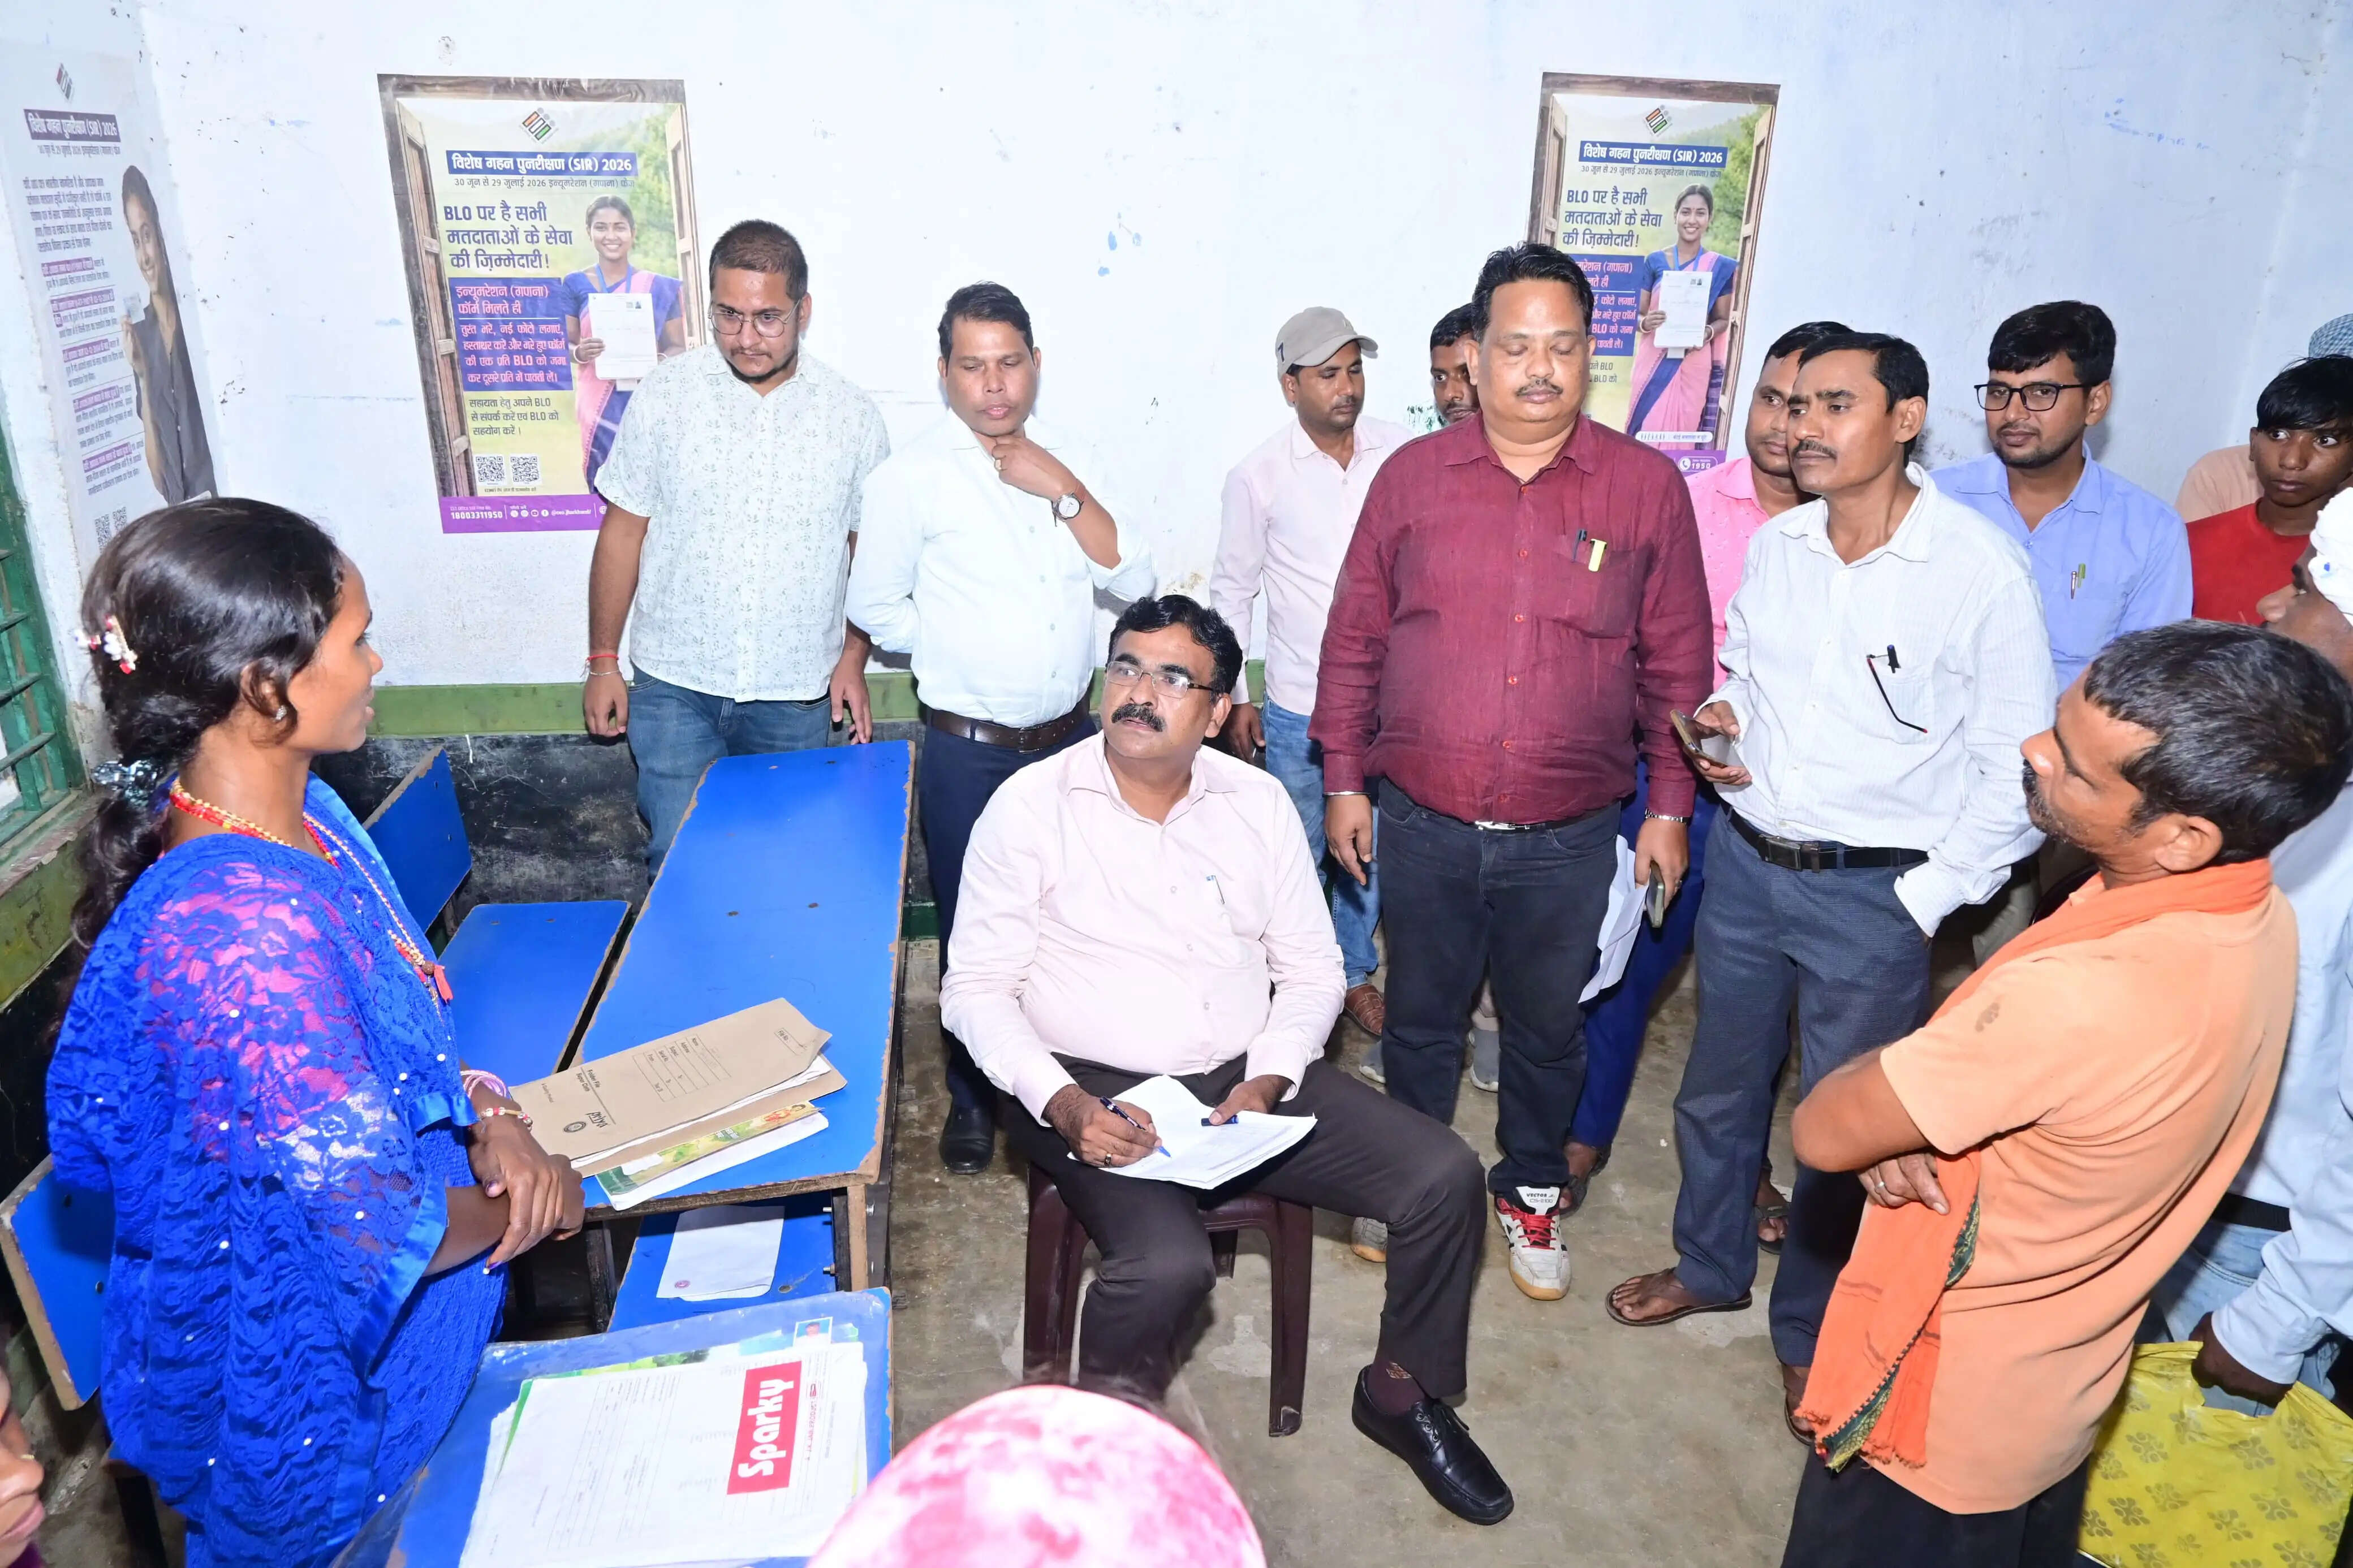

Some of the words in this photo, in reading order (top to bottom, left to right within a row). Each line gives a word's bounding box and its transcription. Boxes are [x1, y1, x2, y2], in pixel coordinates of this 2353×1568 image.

[1584, 142, 1607, 158] विशेष
[1609, 147, 1631, 159] गहन
[1633, 146, 1671, 162] पुनरीक्षण
[1673, 149, 1697, 163] (SIR)
[1699, 152, 1722, 163] 2026
[452, 153, 482, 170] विशेष
[485, 157, 514, 170] गहन
[516, 154, 565, 174] पुनरीक्षण
[568, 158, 598, 172] (SIR)
[602, 159, 632, 171] 2026
[467, 179, 480, 190] जून
[482, 176, 489, 186] से
[504, 176, 524, 189] जुलाई
[1567, 190, 1588, 203] BLO
[1593, 191, 1608, 204] पर
[1611, 185, 1619, 204] है
[1623, 188, 1648, 205] सभी
[444, 206, 472, 221] BLO
[476, 206, 495, 221] पर
[500, 200, 511, 221] है
[515, 201, 547, 221] सभी
[1565, 208, 1622, 225] मतदाताओं
[1625, 209, 1637, 226] के
[1640, 209, 1663, 227] सेवा
[446, 225, 519, 245] मतदाताओं
[524, 225, 540, 245] के
[544, 225, 573, 245] सेवा
[1563, 228, 1579, 245] की
[449, 248, 470, 268] की
[1603, 261, 1632, 274] (गणना)
[1601, 275, 1609, 287] ही
[455, 283, 507, 301] इन्यूमरेशन
[510, 285, 549, 297] (गणना)
[458, 300, 480, 314] फॉर्म
[482, 300, 509, 314] मिलते
[511, 300, 521, 314] ही
[500, 322, 514, 334] नई
[517, 322, 535, 334] फोटो
[1592, 323, 1606, 333] BLO
[1609, 323, 1618, 334] को
[508, 338, 522, 350] और
[536, 340, 546, 352] हुए
[464, 355, 476, 366] की
[479, 357, 493, 366] एक
[514, 355, 533, 366] BLO
[536, 354, 546, 366] को
[550, 356, 566, 366] जमा
[1600, 362, 1613, 370] BLO
[467, 373, 481, 382] कर
[469, 398, 498, 408] सहायता
[500, 396, 511, 409] हेतु
[513, 396, 532, 407] अपने
[535, 398, 550, 407] BLO
[471, 411, 478, 421] से
[530, 412, 546, 421] BLO
[548, 410, 559, 420] को
[473, 425, 500, 435] सहयोग
[451, 511, 502, 520] 18003311950
[585, 1112, 607, 1128] priya
[738, 1378, 794, 1478] Sparky
